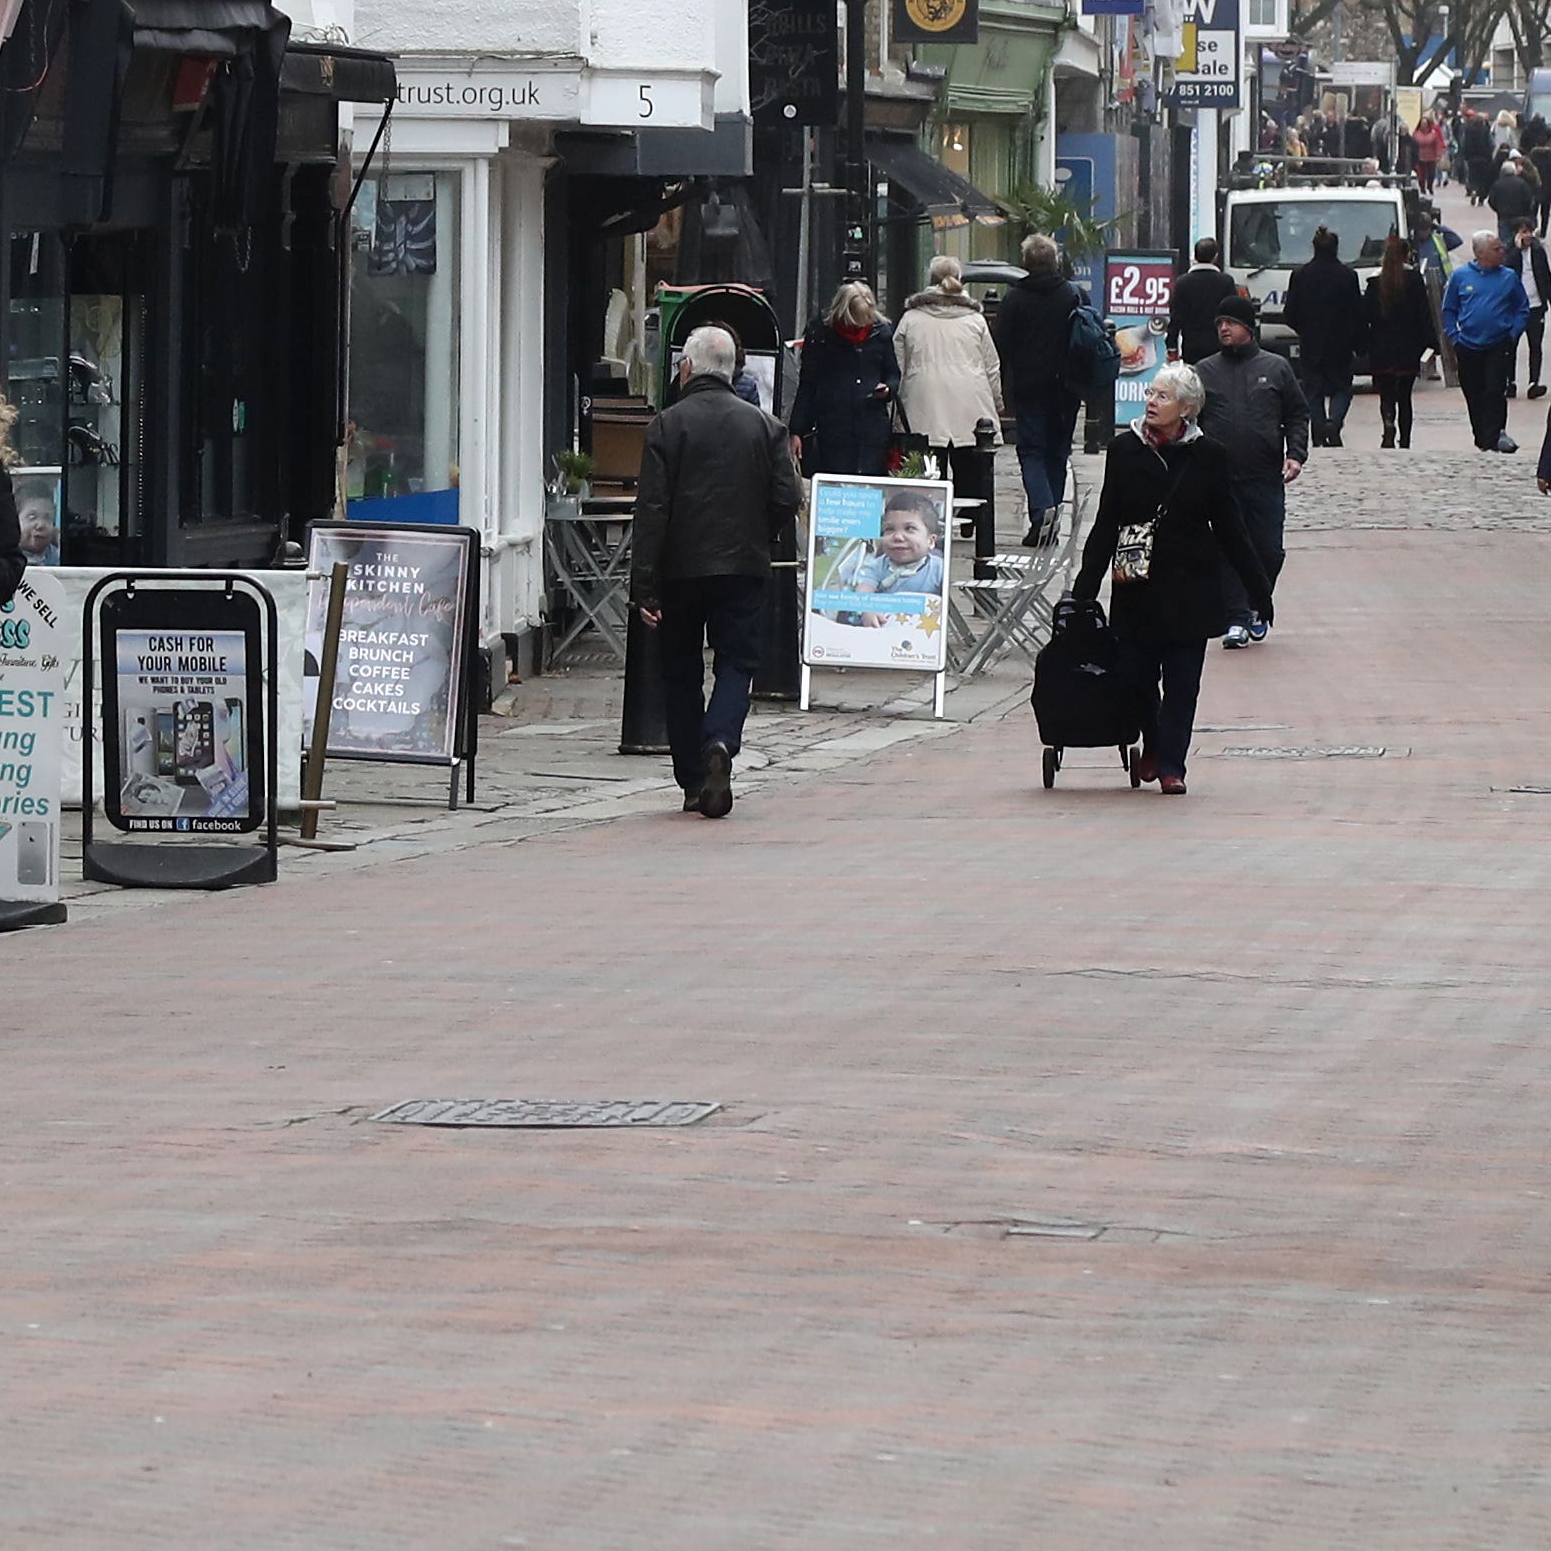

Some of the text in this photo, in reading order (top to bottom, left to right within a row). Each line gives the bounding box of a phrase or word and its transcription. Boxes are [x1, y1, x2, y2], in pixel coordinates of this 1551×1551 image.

[396, 78, 541, 112] trust.org.uk
[1178, 84, 1200, 96] 851
[1203, 84, 1234, 96] 2100
[638, 84, 654, 119] 5
[1110, 265, 1171, 306] £2.95
[376, 552, 399, 563] THE
[353, 564, 421, 579] SKINNY
[346, 579, 425, 595] KITCHEN
[16, 579, 60, 629] WE SELL
[148, 636, 215, 653] CASH FOR
[339, 628, 429, 647] BREAKFAST
[137, 655, 227, 672] YOUR MOBILE
[349, 646, 414, 664] BRUNCH
[349, 663, 411, 680] COFFEE
[352, 681, 404, 697] CAKES
[333, 696, 421, 716] COCKTAILS
[148, 819, 160, 829] US
[192, 819, 242, 831] facebook
